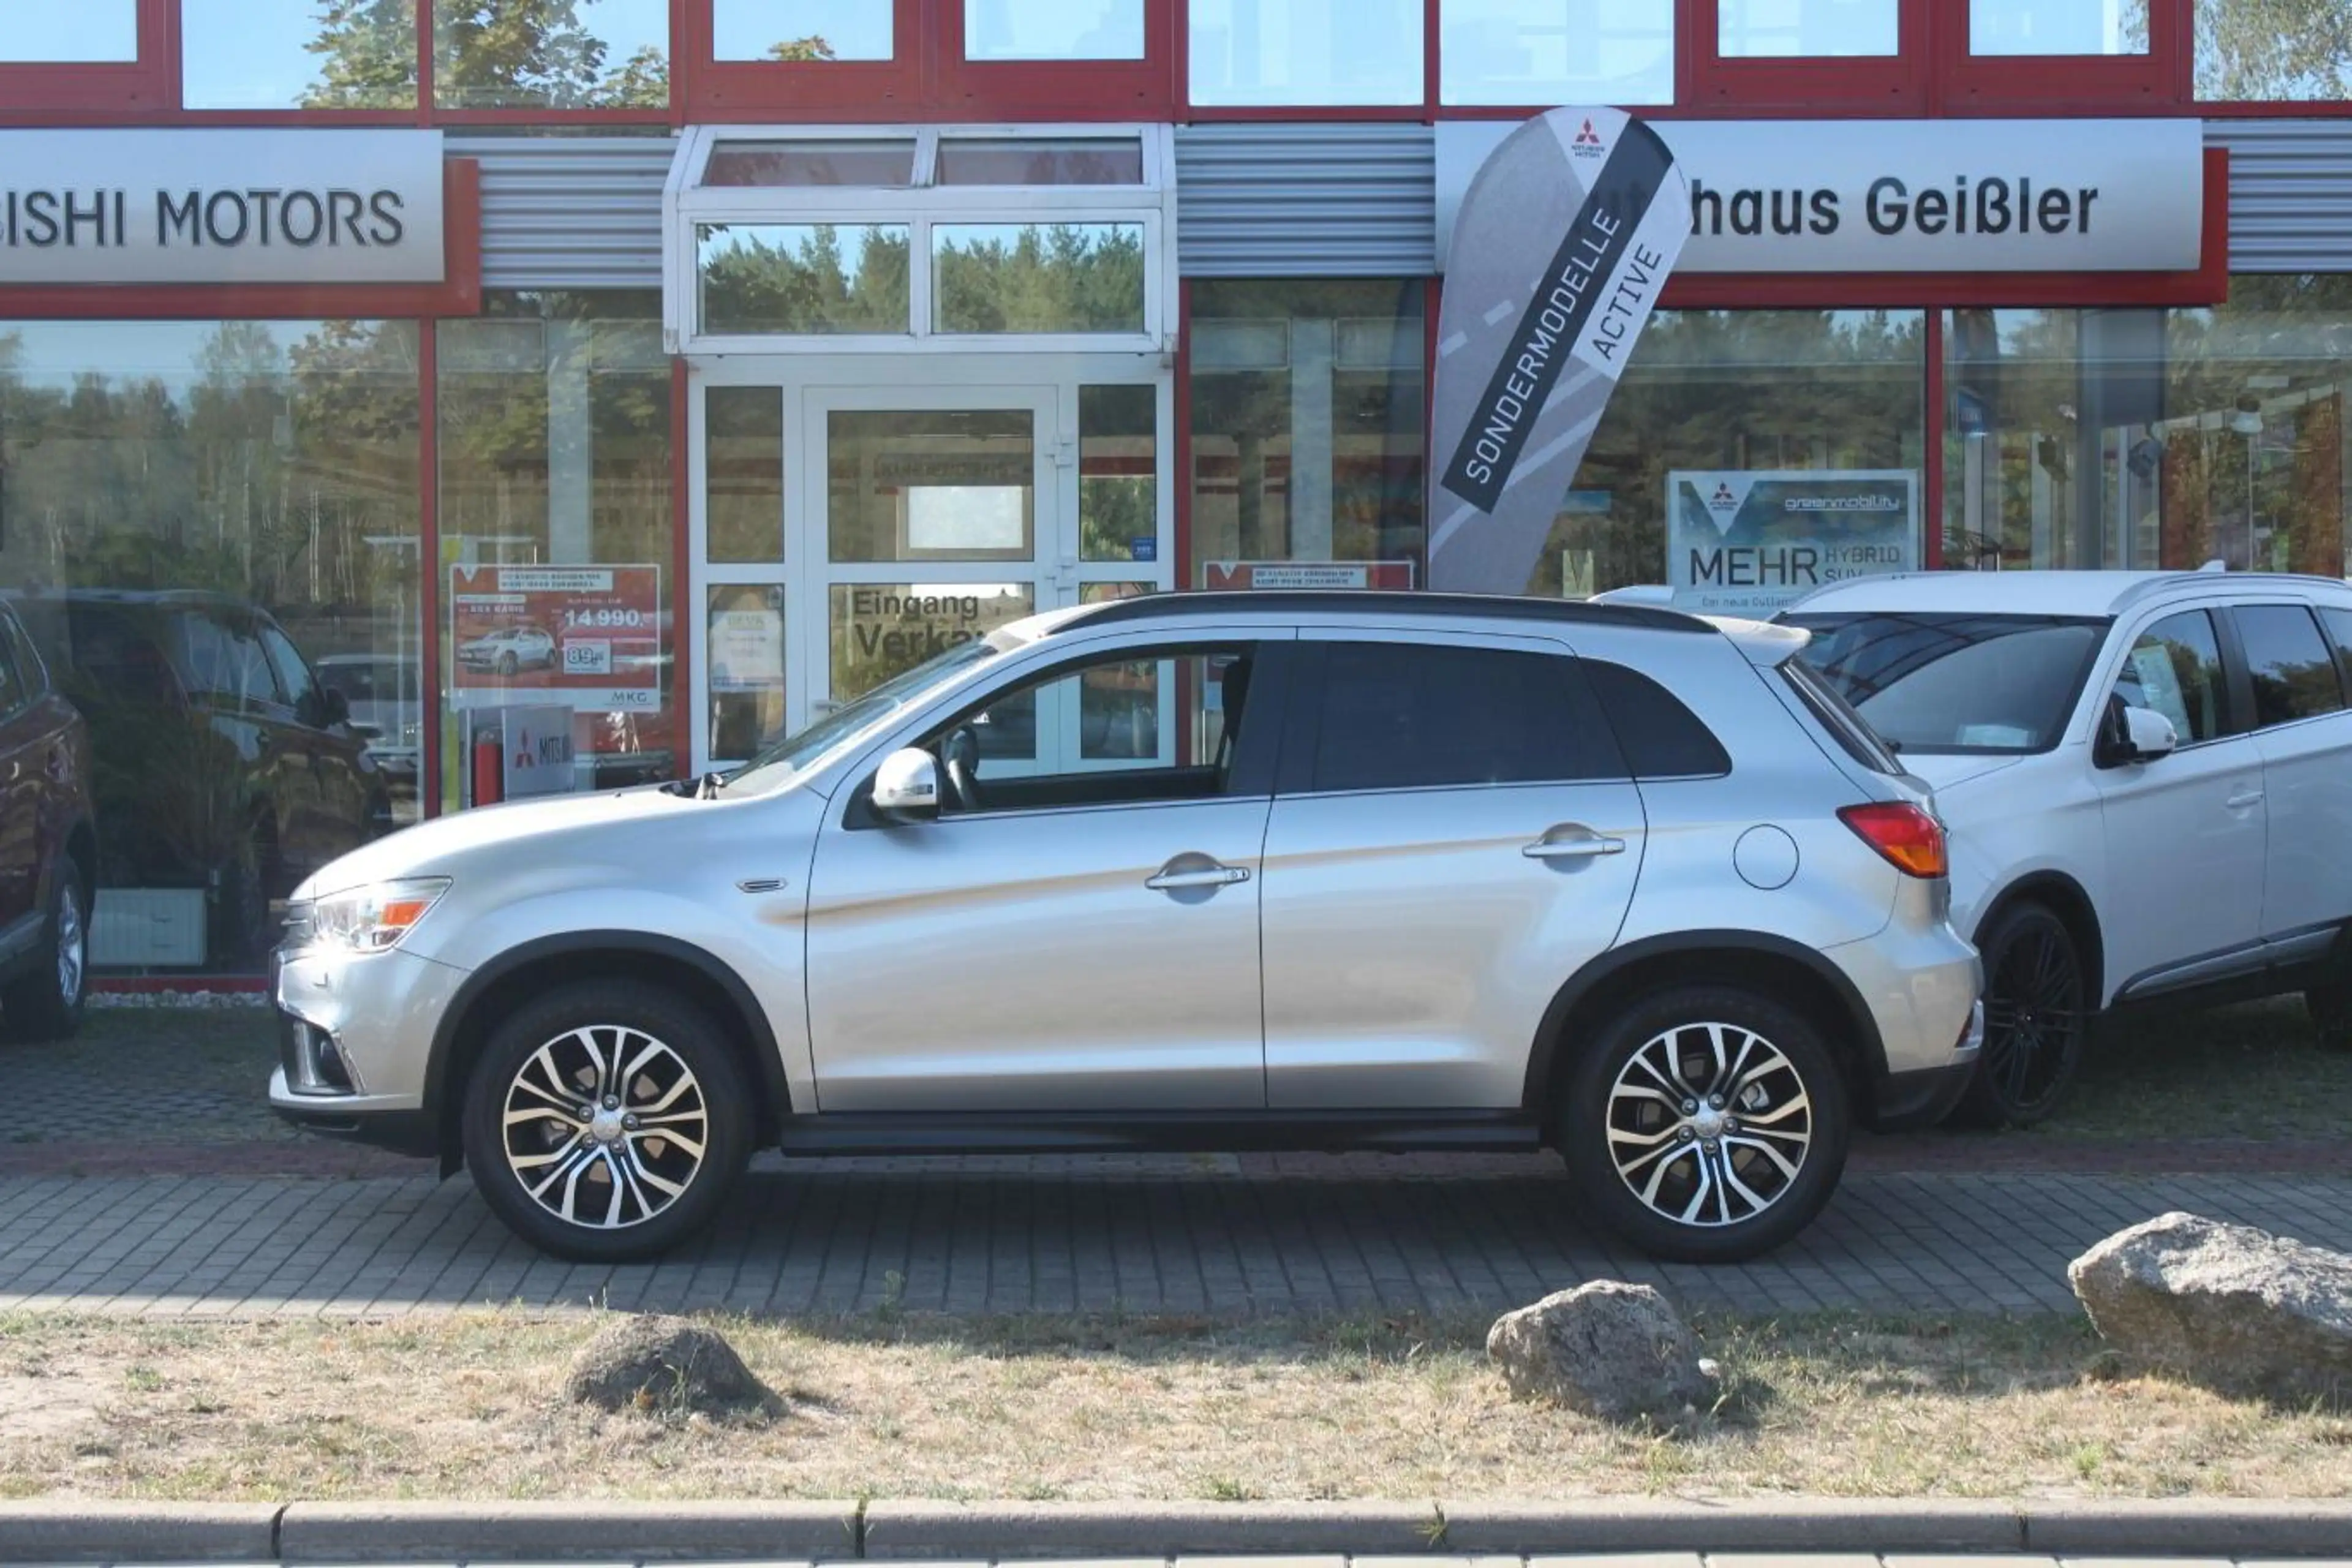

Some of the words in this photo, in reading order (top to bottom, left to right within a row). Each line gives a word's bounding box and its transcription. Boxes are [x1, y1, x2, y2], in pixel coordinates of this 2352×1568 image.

[0, 190, 126, 246] ISHI
[156, 189, 404, 246] MOTORS
[1865, 176, 2098, 235] Geißler
[1593, 243, 1662, 361] ACTIVE
[1466, 208, 1622, 484] SONDERMODELLE
[1689, 547, 1819, 586] MEHR
[1823, 545, 1900, 564] HYBRID
[853, 590, 979, 625] Eingang
[854, 622, 984, 660] Verka
